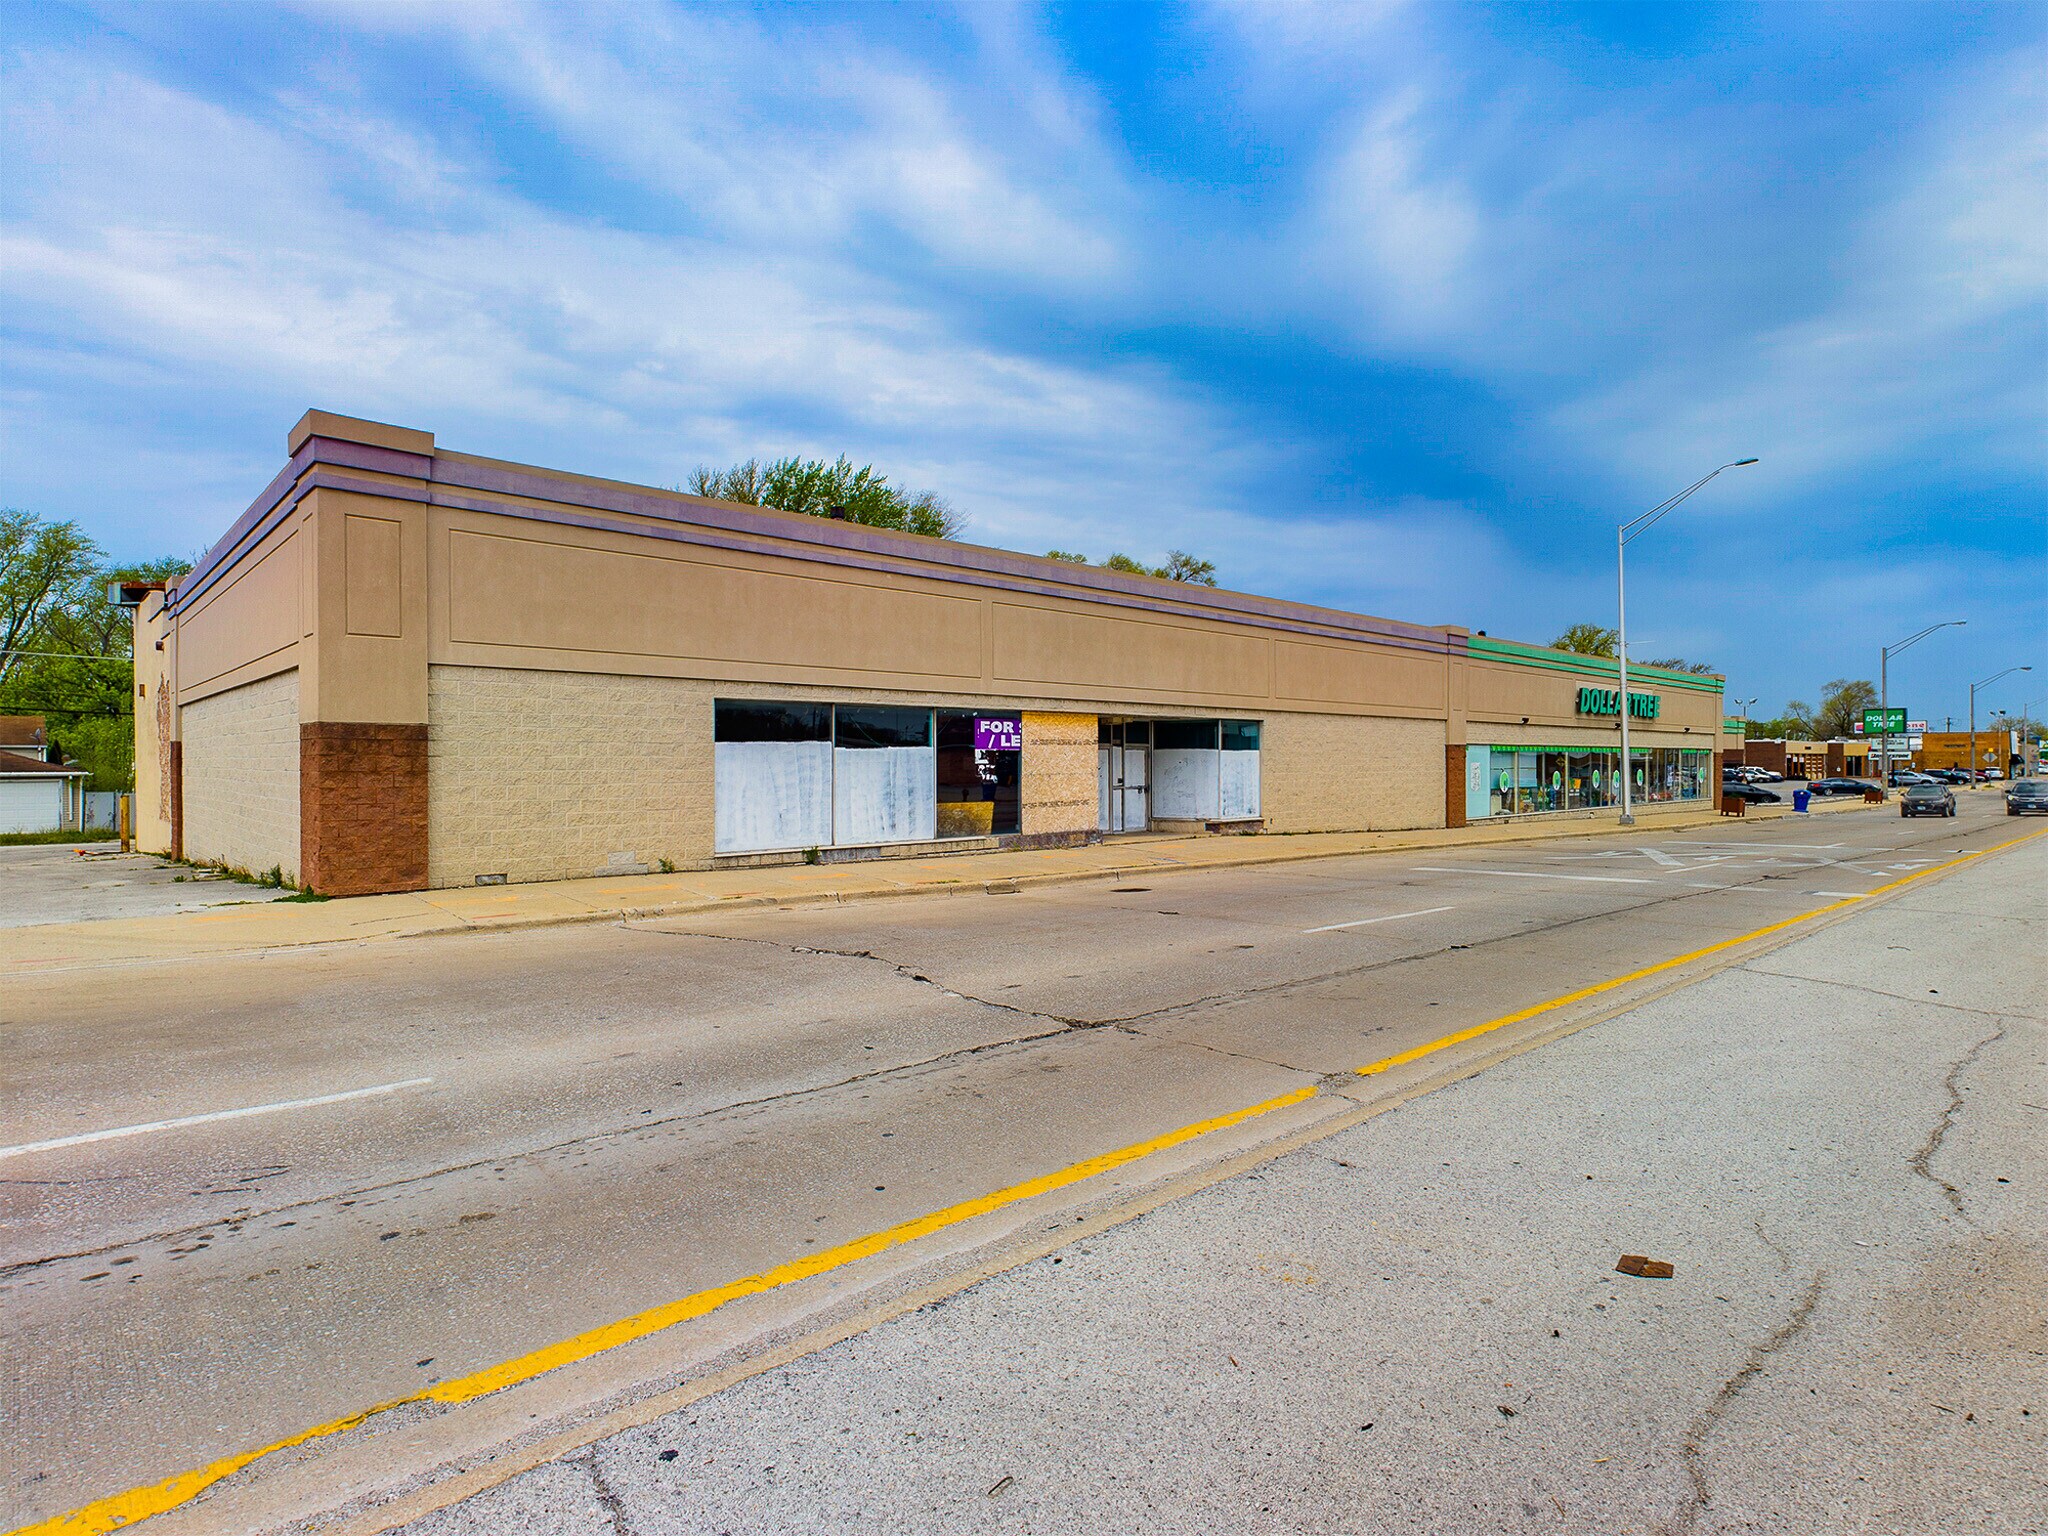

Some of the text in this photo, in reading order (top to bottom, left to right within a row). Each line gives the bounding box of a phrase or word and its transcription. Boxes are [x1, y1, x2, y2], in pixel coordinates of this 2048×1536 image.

[1579, 687, 1661, 718] DOLLAR TREE
[980, 721, 1014, 733] FOR
